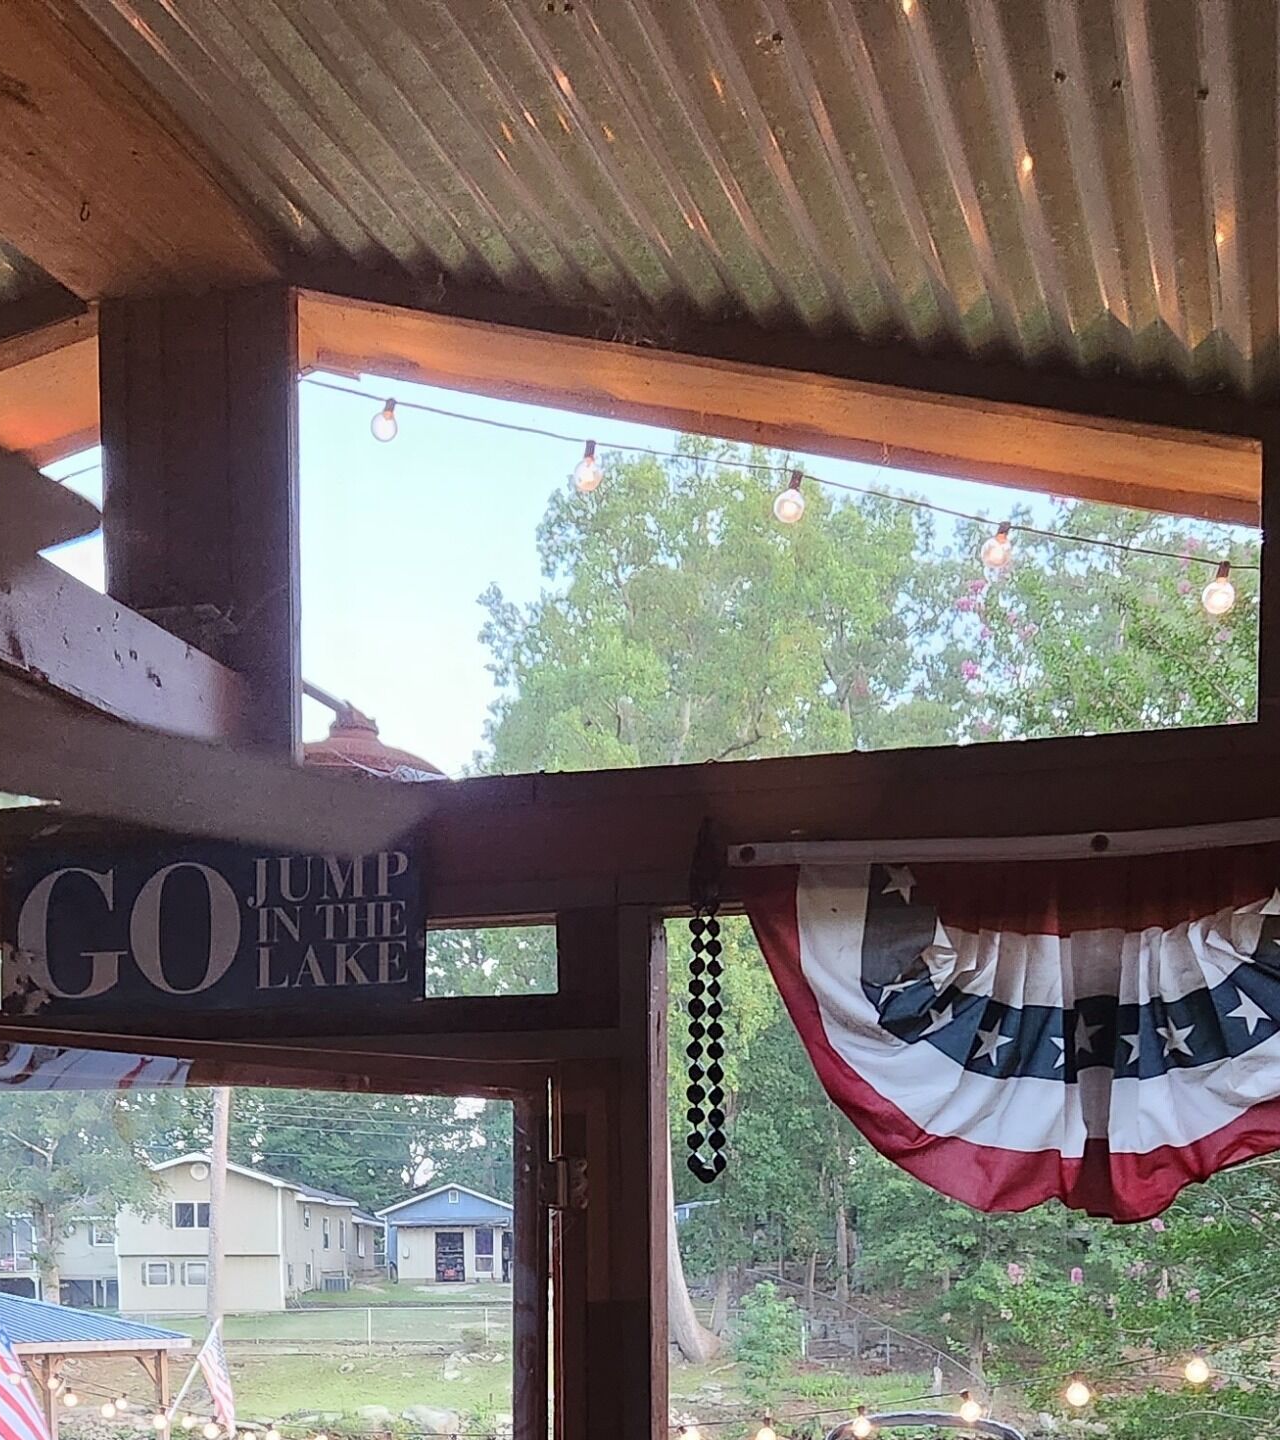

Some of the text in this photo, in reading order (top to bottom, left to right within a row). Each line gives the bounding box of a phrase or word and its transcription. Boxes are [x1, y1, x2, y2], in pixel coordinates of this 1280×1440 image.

[247, 851, 409, 908] JUMP
[17, 861, 241, 999] GO
[258, 900, 407, 943] IN THE
[255, 940, 409, 990] LAKE
